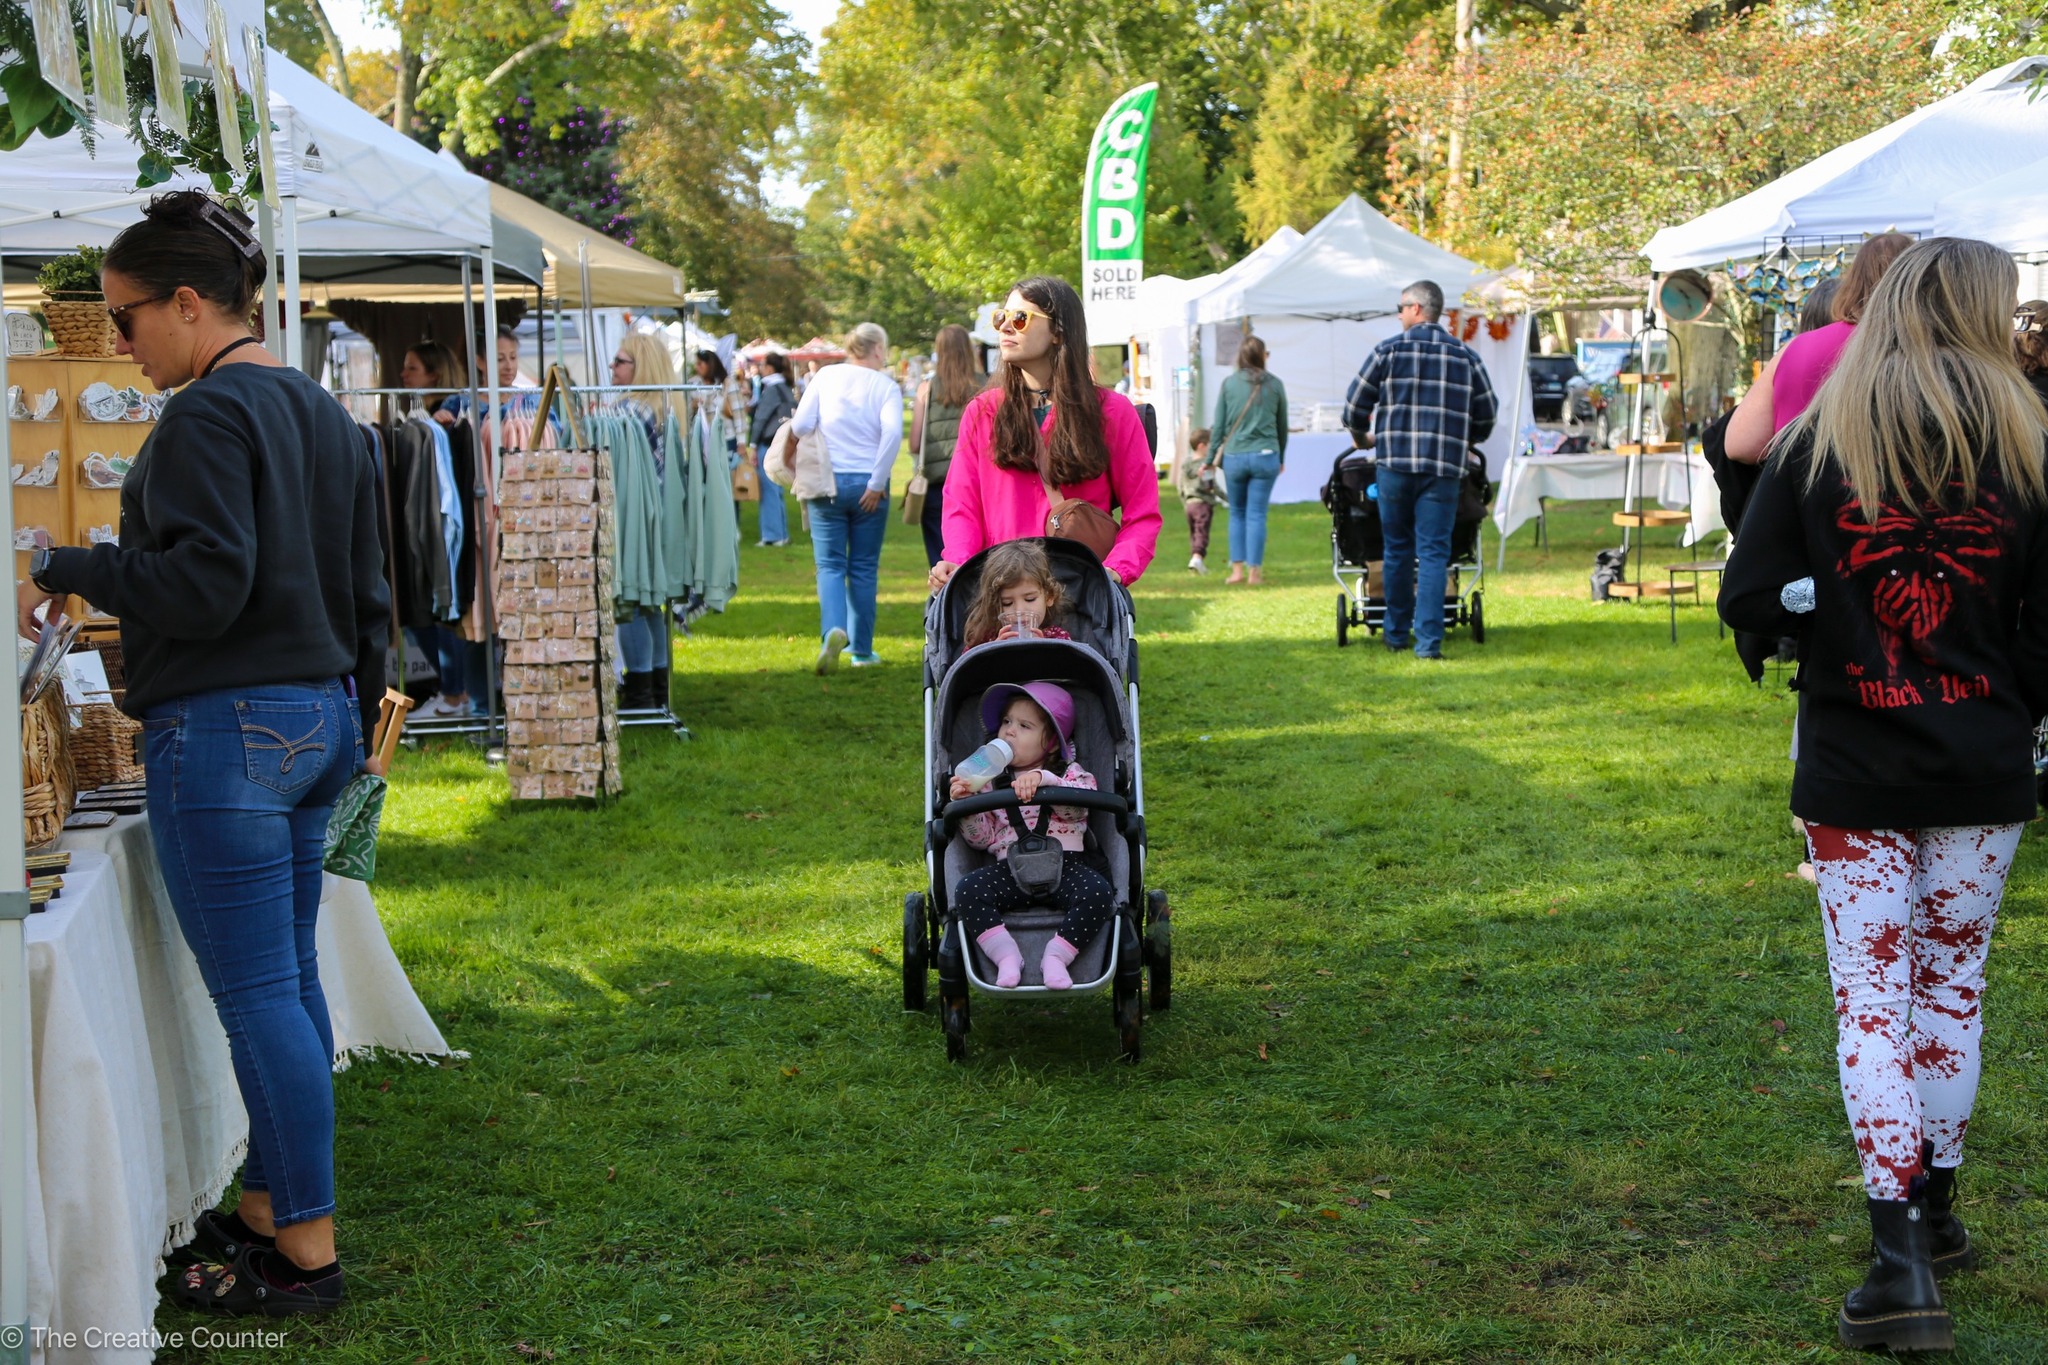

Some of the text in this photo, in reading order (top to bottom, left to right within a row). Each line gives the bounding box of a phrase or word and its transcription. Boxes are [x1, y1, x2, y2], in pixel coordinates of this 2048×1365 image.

[1098, 109, 1143, 249] CBD
[1093, 267, 1137, 283] SOLD
[1091, 285, 1136, 301] HERE
[1845, 661, 1864, 677] the
[1853, 673, 1990, 709] Black Veil
